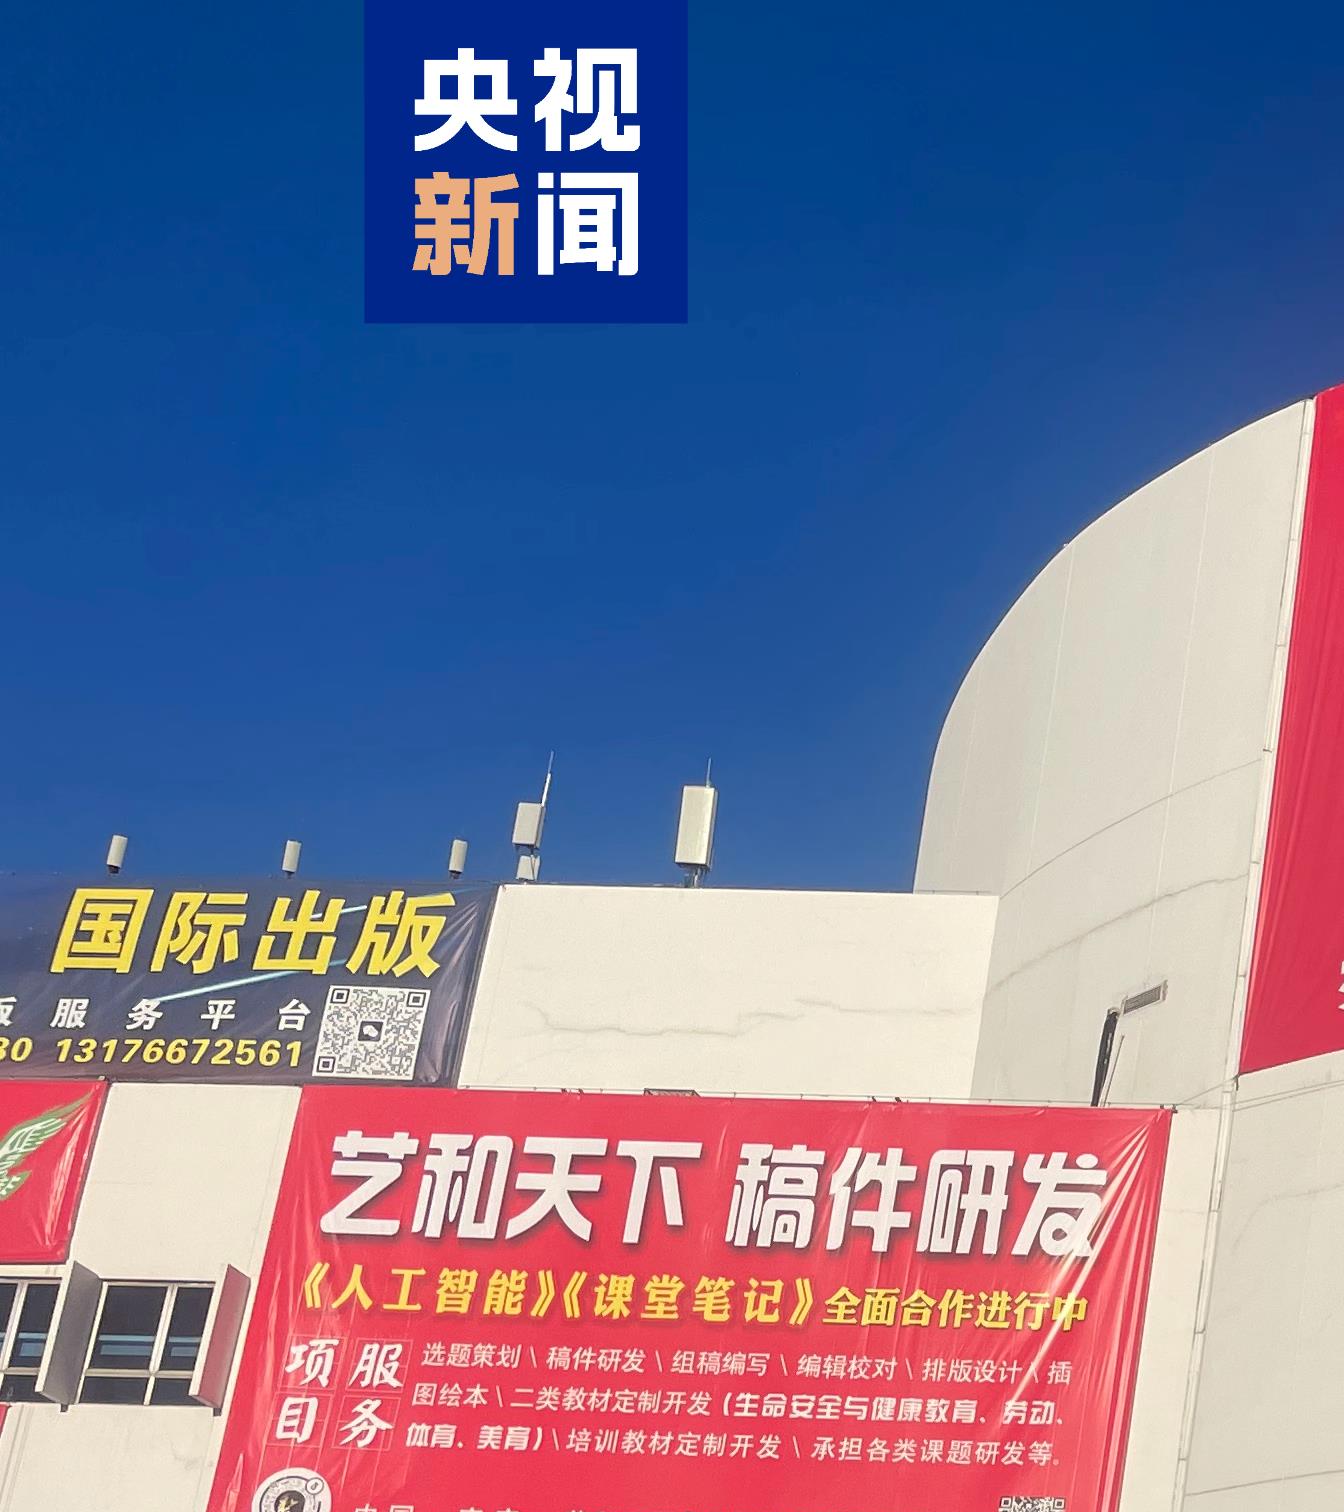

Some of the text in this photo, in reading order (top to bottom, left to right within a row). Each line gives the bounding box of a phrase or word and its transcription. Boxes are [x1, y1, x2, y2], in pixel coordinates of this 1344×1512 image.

[50, 887, 456, 977] 国际出版
[56, 1038, 302, 1067] 13176672561
[320, 1129, 1108, 1257] 艺和天下 稿件研发
